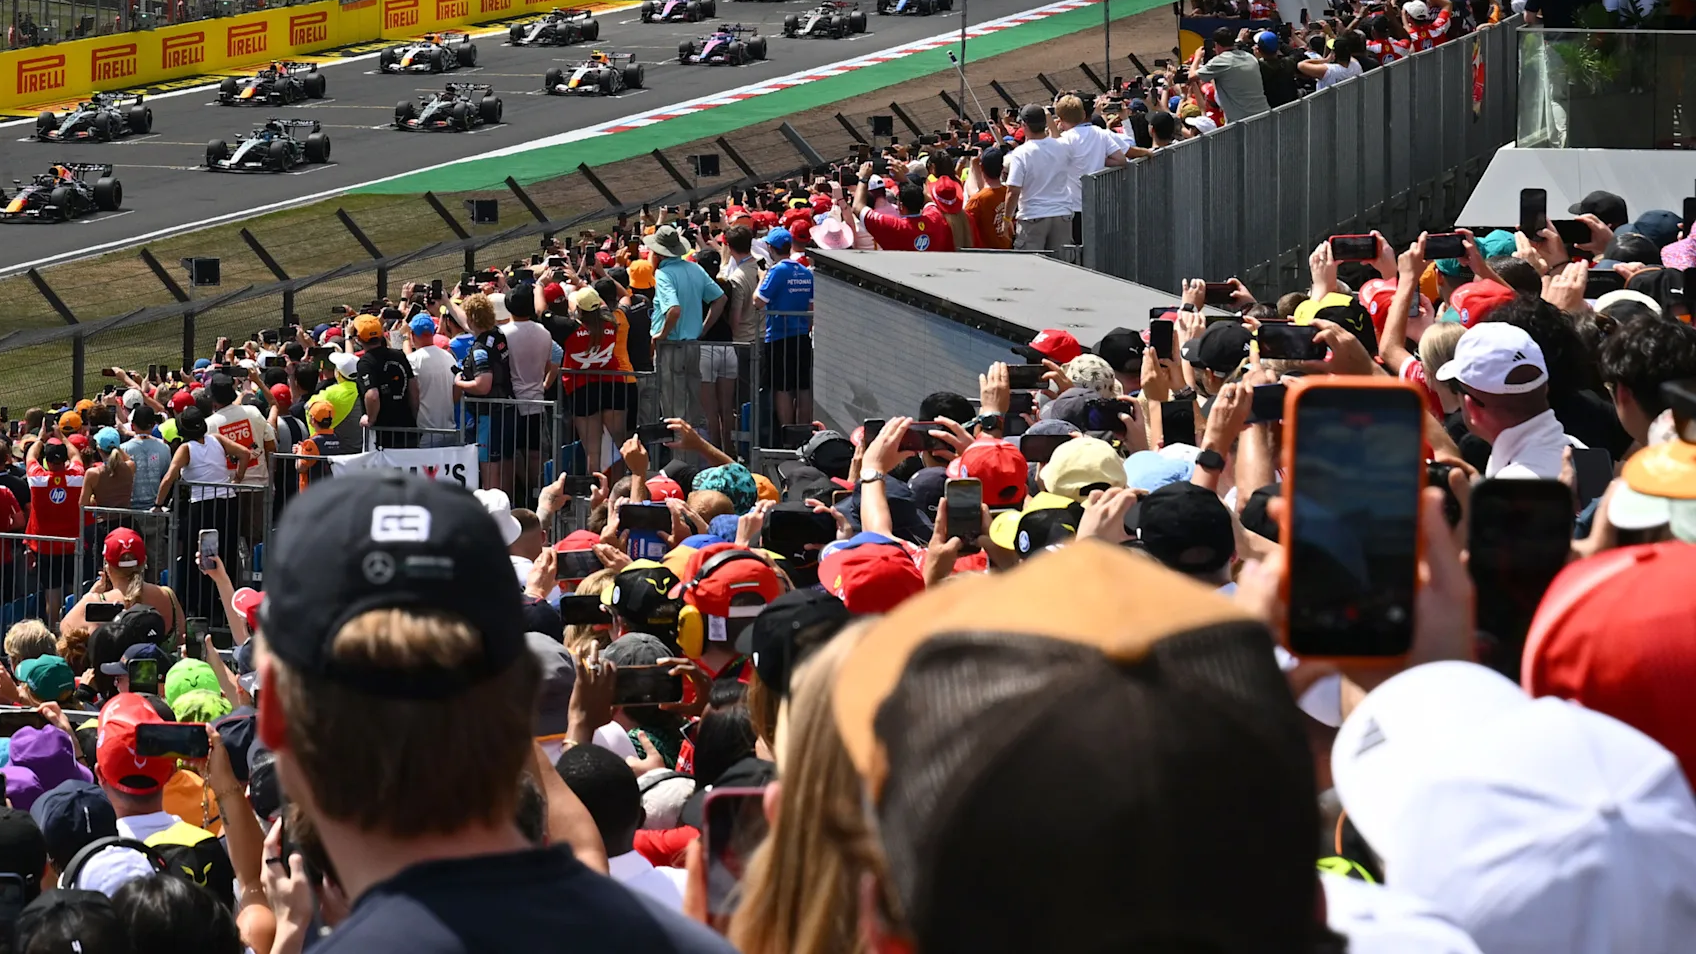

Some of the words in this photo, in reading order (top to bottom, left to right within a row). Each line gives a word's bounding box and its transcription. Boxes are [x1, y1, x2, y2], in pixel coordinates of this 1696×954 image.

[291, 13, 328, 47] PIRELLI
[386, 0, 419, 30] PIRELLI
[163, 33, 205, 69] PIRELLI
[229, 23, 269, 58] PIRELLI
[18, 55, 66, 95] PIRELLI
[93, 45, 137, 83] PIRELLI
